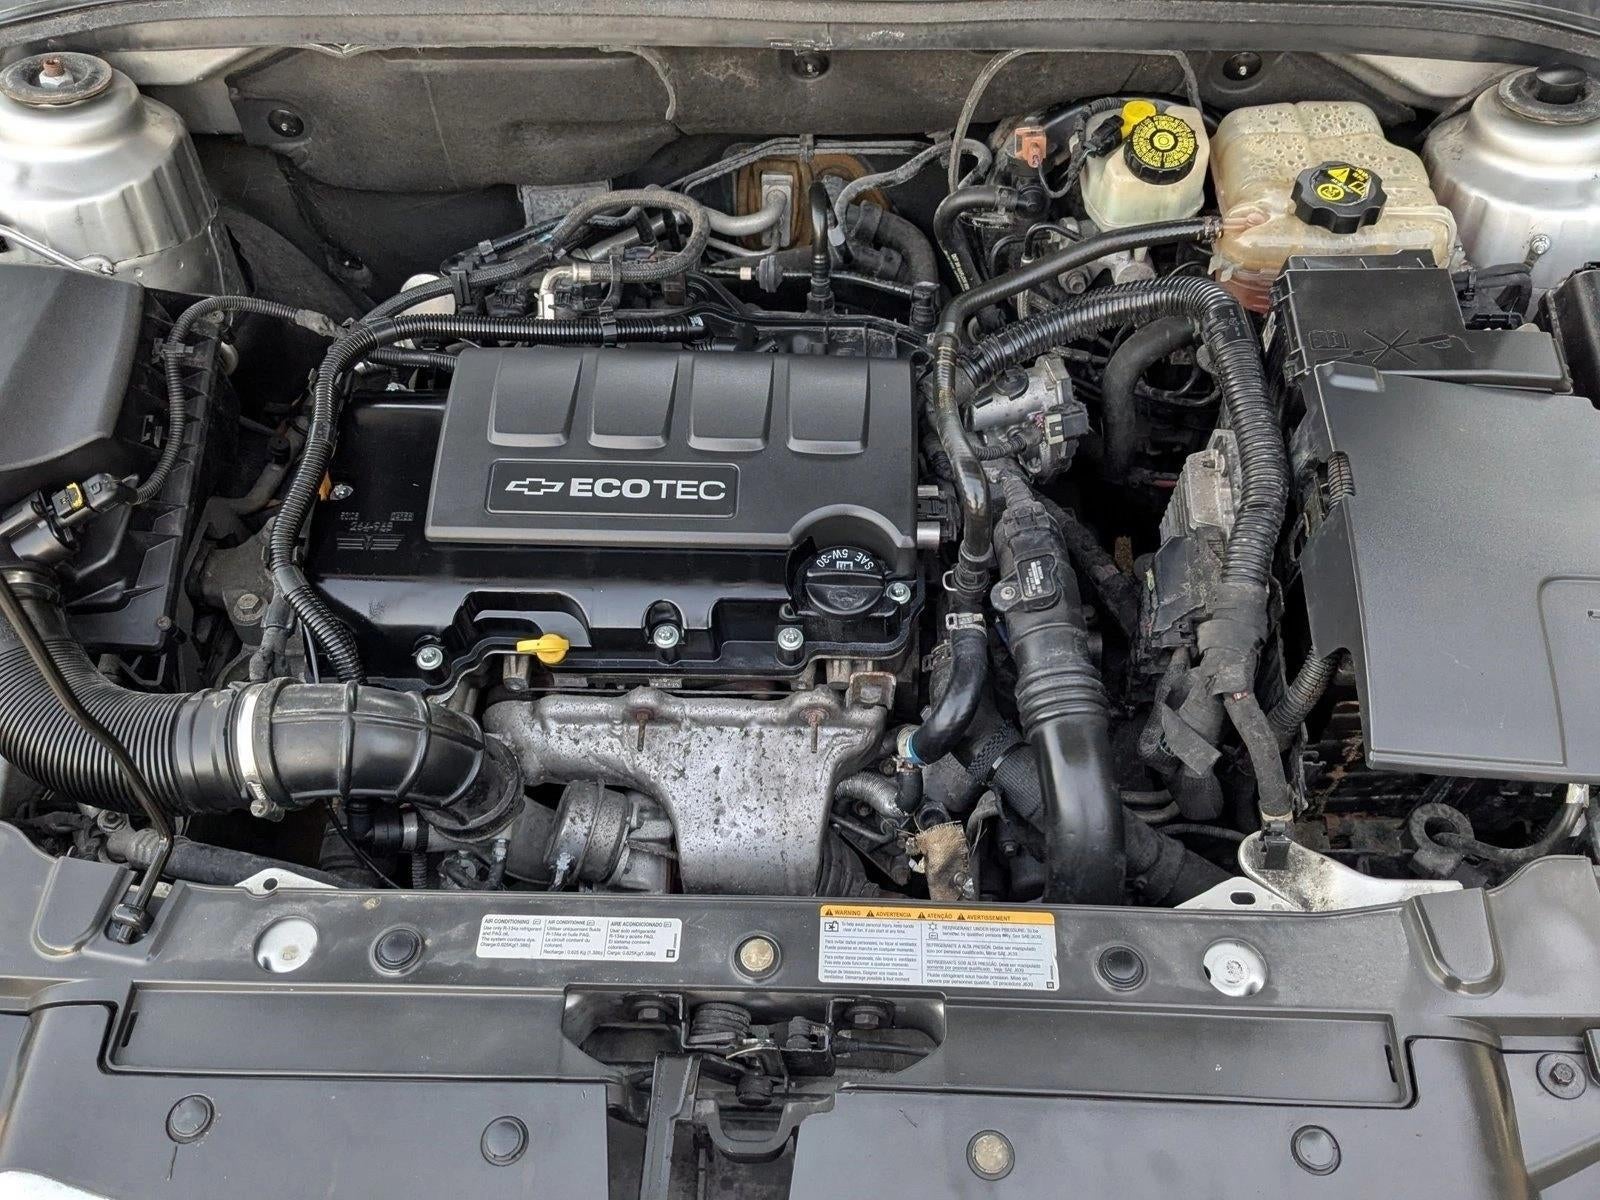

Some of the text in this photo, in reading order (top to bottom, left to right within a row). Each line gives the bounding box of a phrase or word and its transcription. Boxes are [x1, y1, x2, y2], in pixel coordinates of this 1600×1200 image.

[570, 478, 725, 500] ECOTEC
[816, 548, 874, 570] SAE 5W-30
[927, 912, 953, 920] ATENÇÃO
